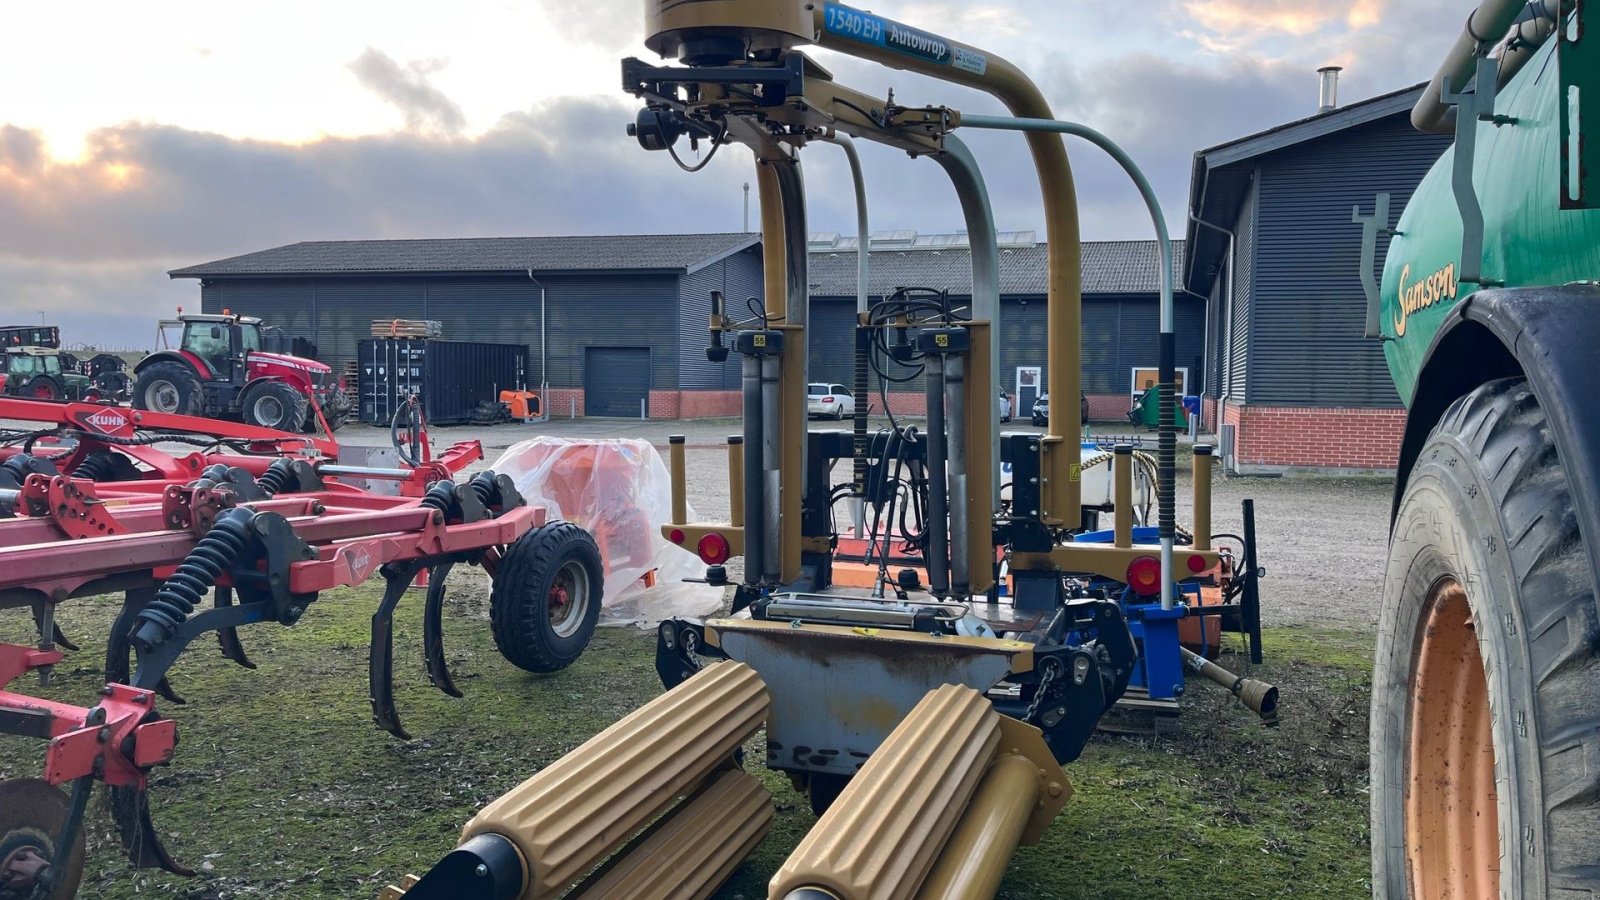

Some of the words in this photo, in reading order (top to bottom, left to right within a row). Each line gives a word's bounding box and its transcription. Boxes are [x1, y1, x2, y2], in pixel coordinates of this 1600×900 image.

[829, 8, 861, 34] 1540
[864, 19, 881, 41] EH
[890, 25, 946, 61] Autowrap
[1394, 262, 1457, 337] Samson
[755, 337, 765, 345] 55
[937, 336, 947, 344] 55
[92, 414, 125, 426] KUHN
